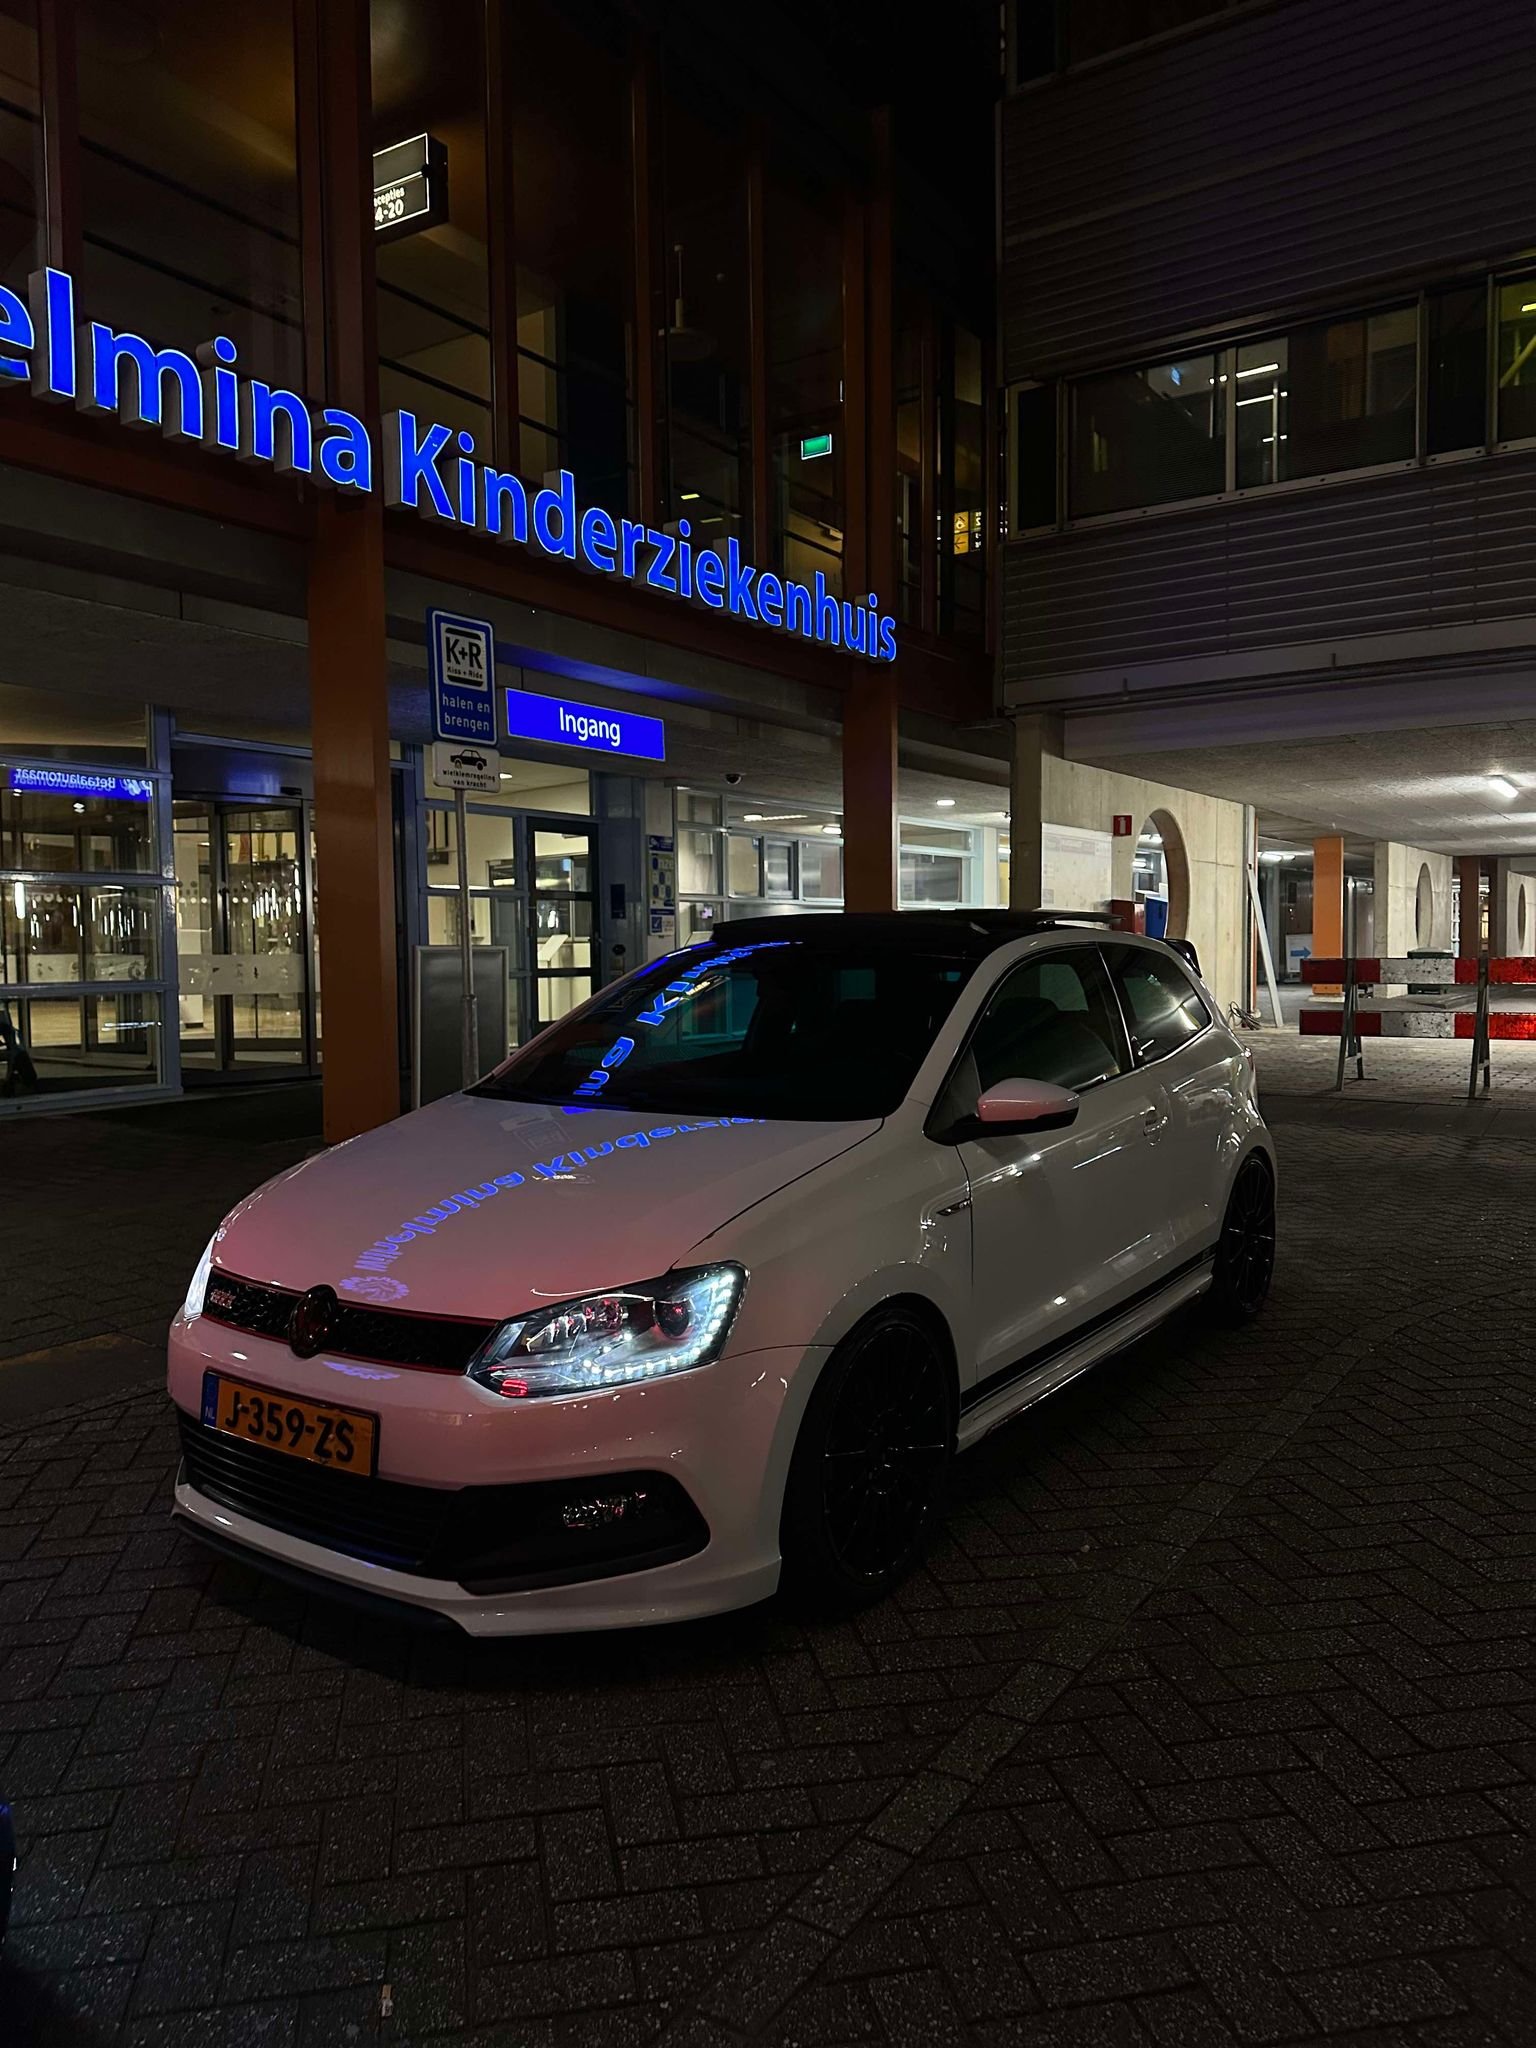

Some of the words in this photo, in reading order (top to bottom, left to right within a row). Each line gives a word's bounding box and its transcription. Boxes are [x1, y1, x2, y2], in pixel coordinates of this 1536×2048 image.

[398, 410, 897, 662] Kinderziekenhuis
[445, 636, 483, 670] K+R
[442, 693, 473, 711] halen
[477, 701, 491, 714] en
[444, 713, 490, 734] brengen
[560, 707, 621, 747] Ingang
[442, 769, 496, 783] wielklemregeling
[466, 780, 487, 789] kracht
[204, 1406, 216, 1420] NL
[224, 1391, 355, 1463] J-359-ZS
